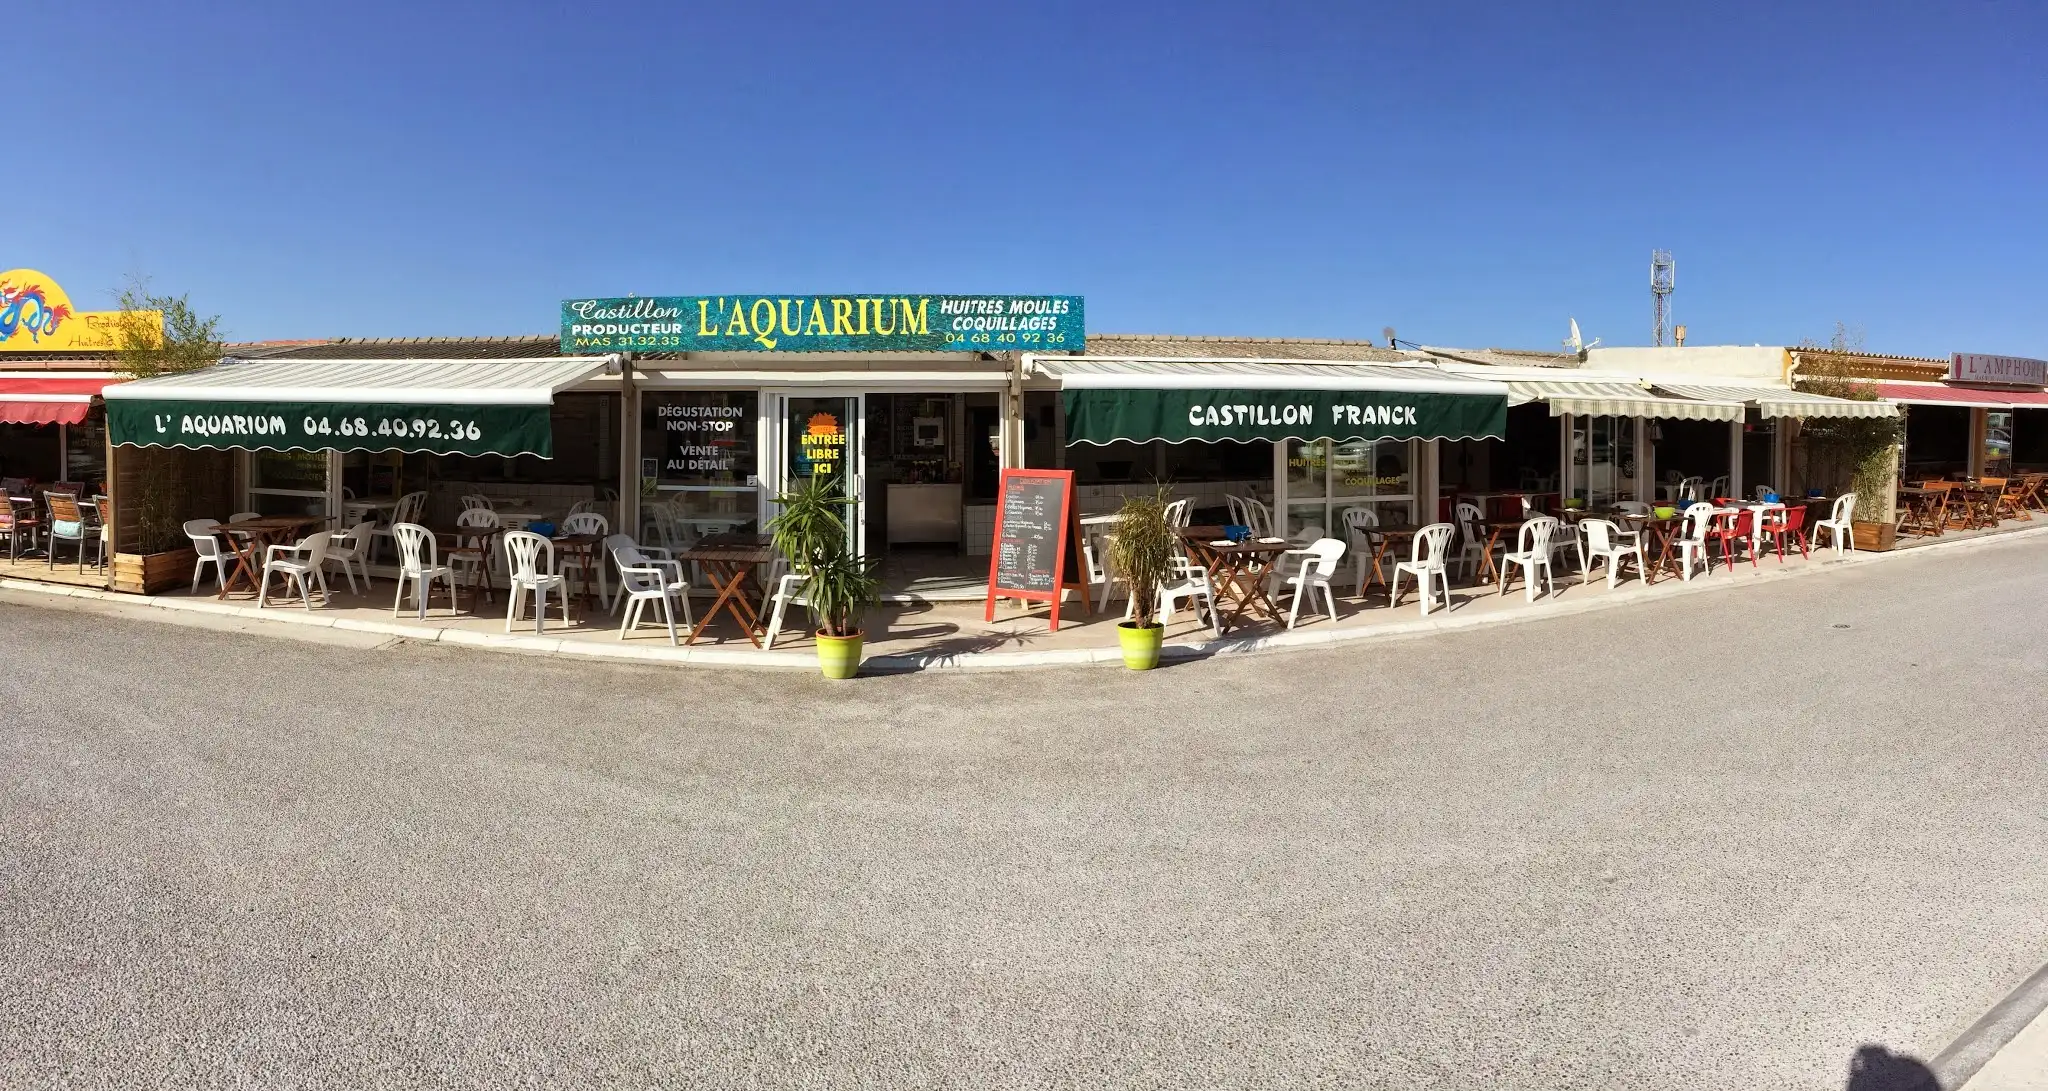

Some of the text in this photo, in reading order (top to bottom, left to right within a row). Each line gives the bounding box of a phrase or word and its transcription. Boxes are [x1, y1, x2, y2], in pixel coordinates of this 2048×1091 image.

[572, 299, 682, 320] Castillon
[940, 299, 1069, 314] HUITRES MOULES
[571, 323, 682, 335] PRODUCTEUR
[697, 297, 929, 349] L'AQUARIUM
[952, 316, 1057, 332] COQUILLAGES
[575, 337, 680, 346] MAS 31.32.33
[945, 333, 1065, 343] 04 68 40 92 36
[658, 404, 743, 417] DÉGUSTATION
[1189, 404, 1417, 426] CASTILLON FRANCK
[181, 415, 286, 437] AQUARIUM
[303, 416, 481, 441] 04.68.40.92.36
[667, 421, 734, 432] NON-STOP
[680, 445, 719, 456] VENTE
[806, 448, 839, 459] LIBRE
[667, 457, 729, 470] AU DÉTAIL
[814, 463, 832, 474] ICI
